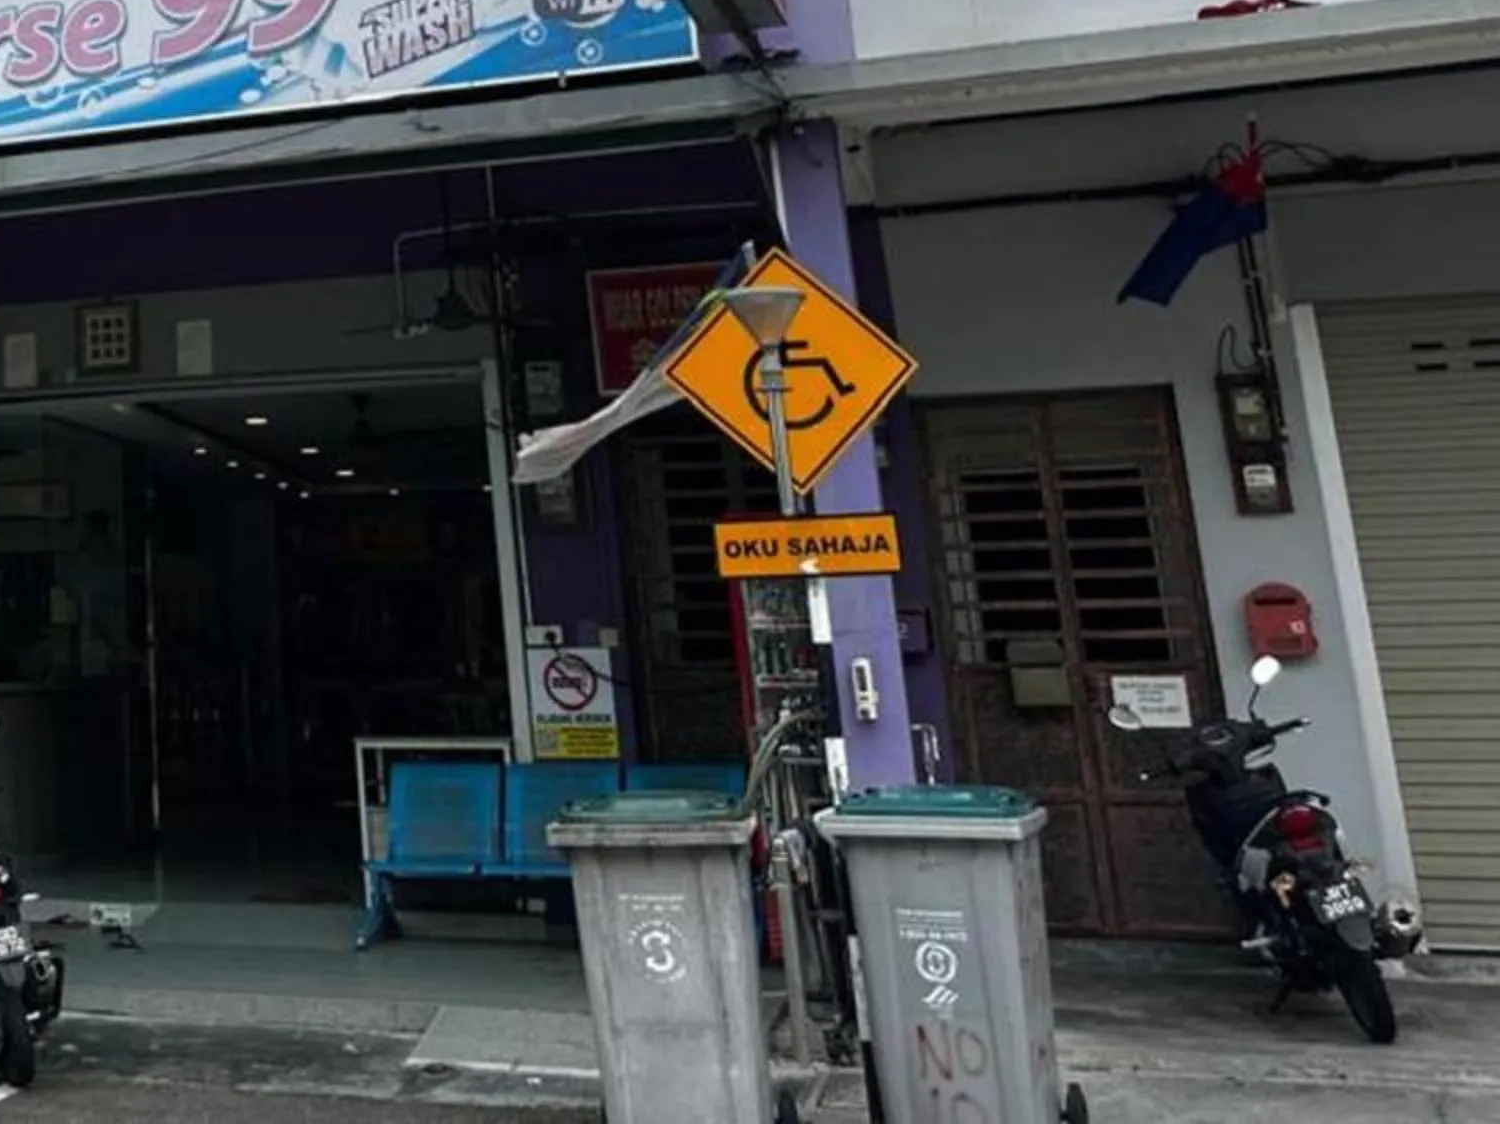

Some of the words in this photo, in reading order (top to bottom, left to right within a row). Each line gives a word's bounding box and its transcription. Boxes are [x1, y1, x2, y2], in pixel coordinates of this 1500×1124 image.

[363, 1, 476, 79] WASH
[723, 539, 779, 559] OKU
[787, 533, 891, 557] SAHAJA
